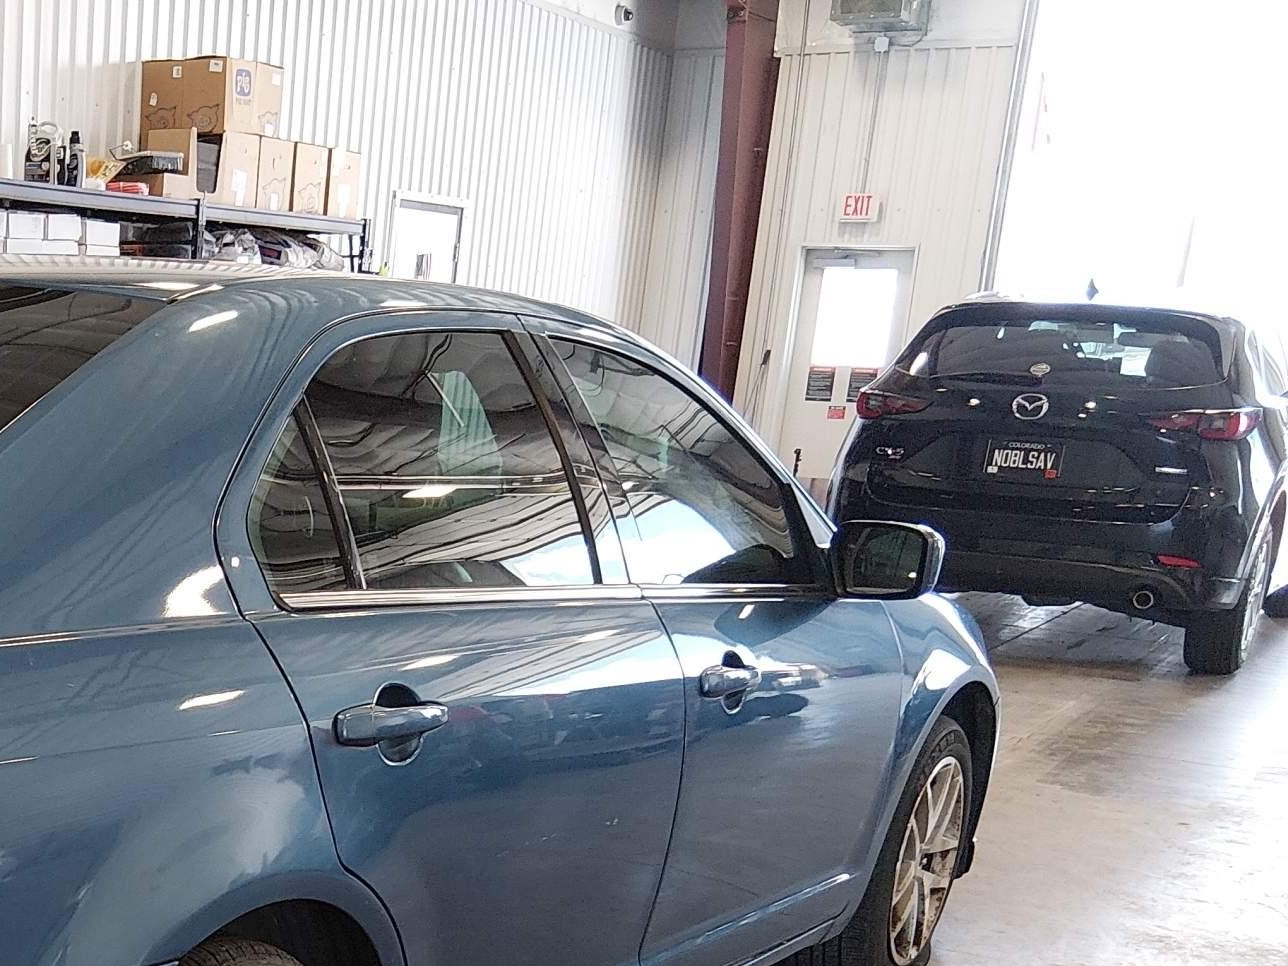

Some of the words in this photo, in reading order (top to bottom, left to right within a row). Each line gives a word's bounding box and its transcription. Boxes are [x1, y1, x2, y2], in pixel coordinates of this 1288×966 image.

[843, 195, 872, 216] EXIT
[1008, 441, 1045, 450] COLORADO
[992, 448, 1057, 471] NOBLSAV
